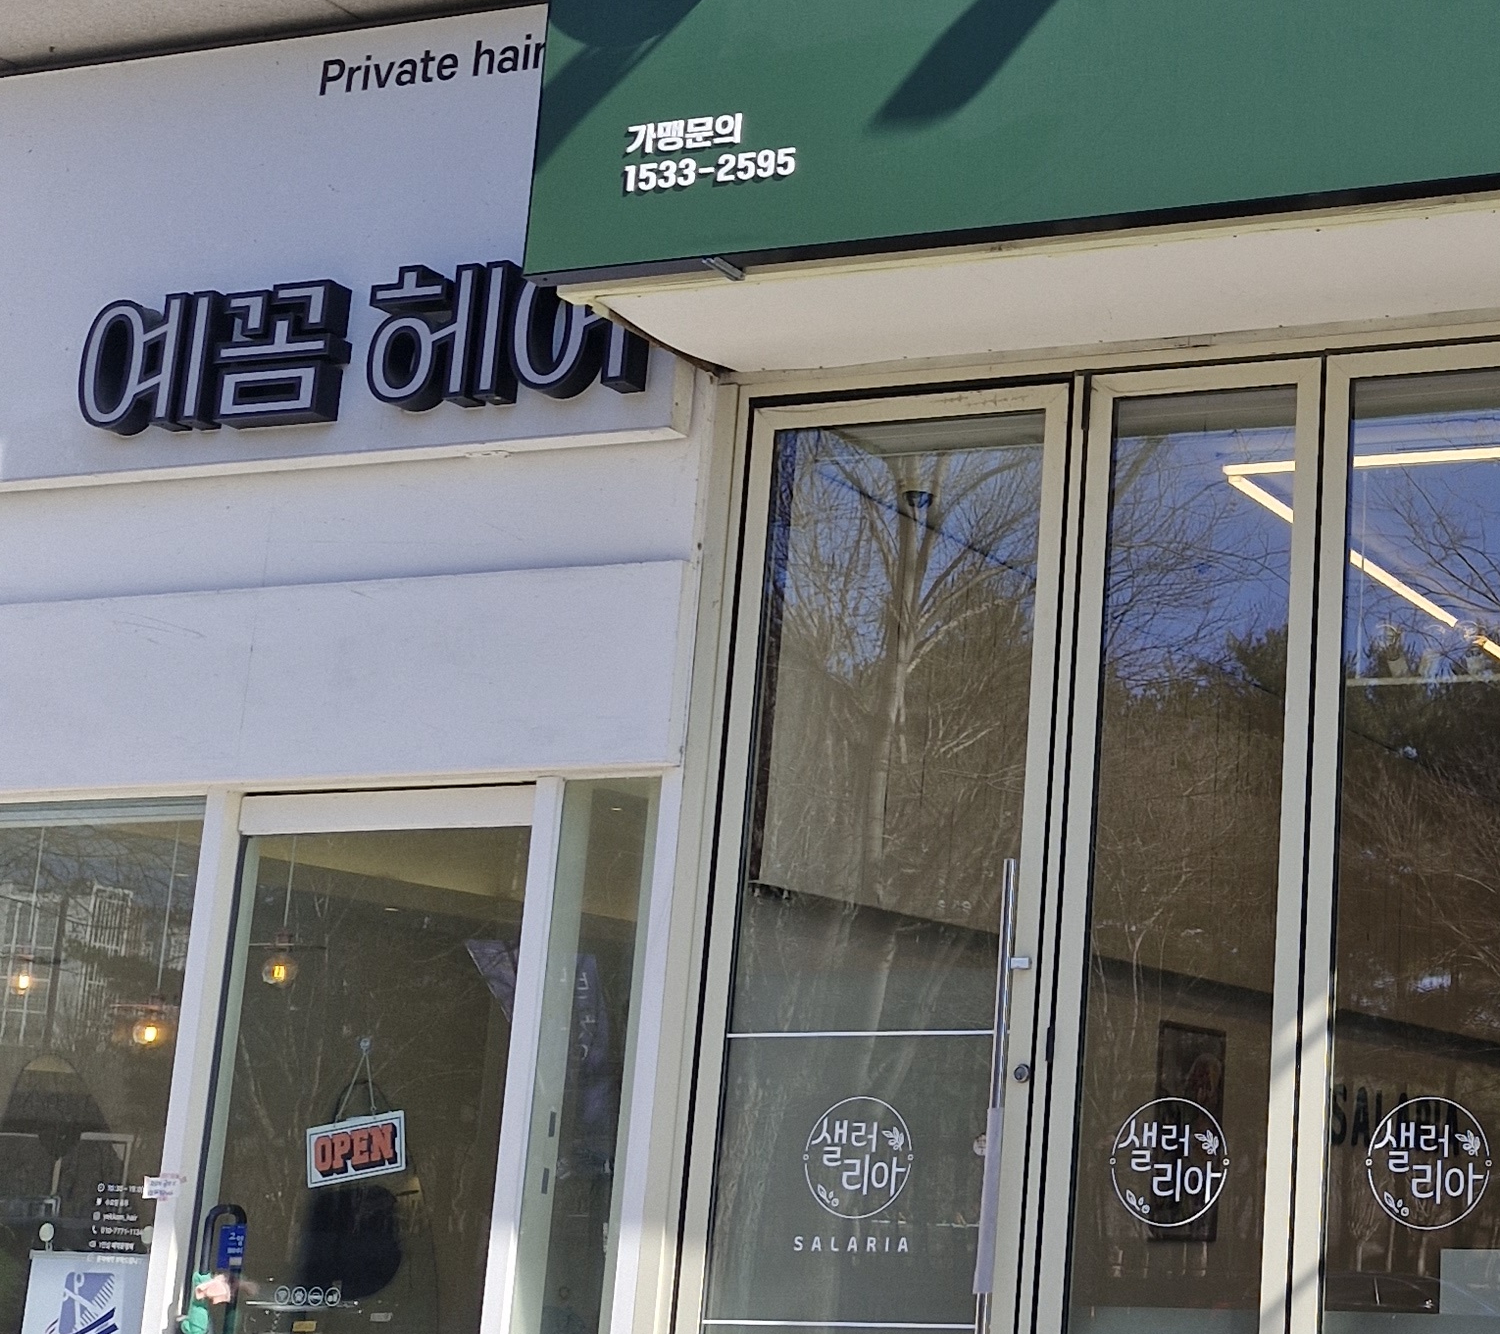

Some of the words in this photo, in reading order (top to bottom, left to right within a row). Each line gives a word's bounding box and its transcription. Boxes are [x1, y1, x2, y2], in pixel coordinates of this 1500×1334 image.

[319, 49, 458, 96] Private
[625, 112, 743, 154] 가맹문의
[624, 147, 796, 192] 1533-2595
[79, 280, 352, 435] 예꼼
[314, 1122, 398, 1178] OPEN
[811, 1116, 878, 1167] 샐러
[1118, 1119, 1190, 1172] 샐러
[1374, 1119, 1449, 1174] 샐러
[841, 1153, 907, 1197] 리아
[1152, 1158, 1222, 1204] 리아
[1410, 1159, 1485, 1206] 리아
[793, 1235, 909, 1253] SALARIA
